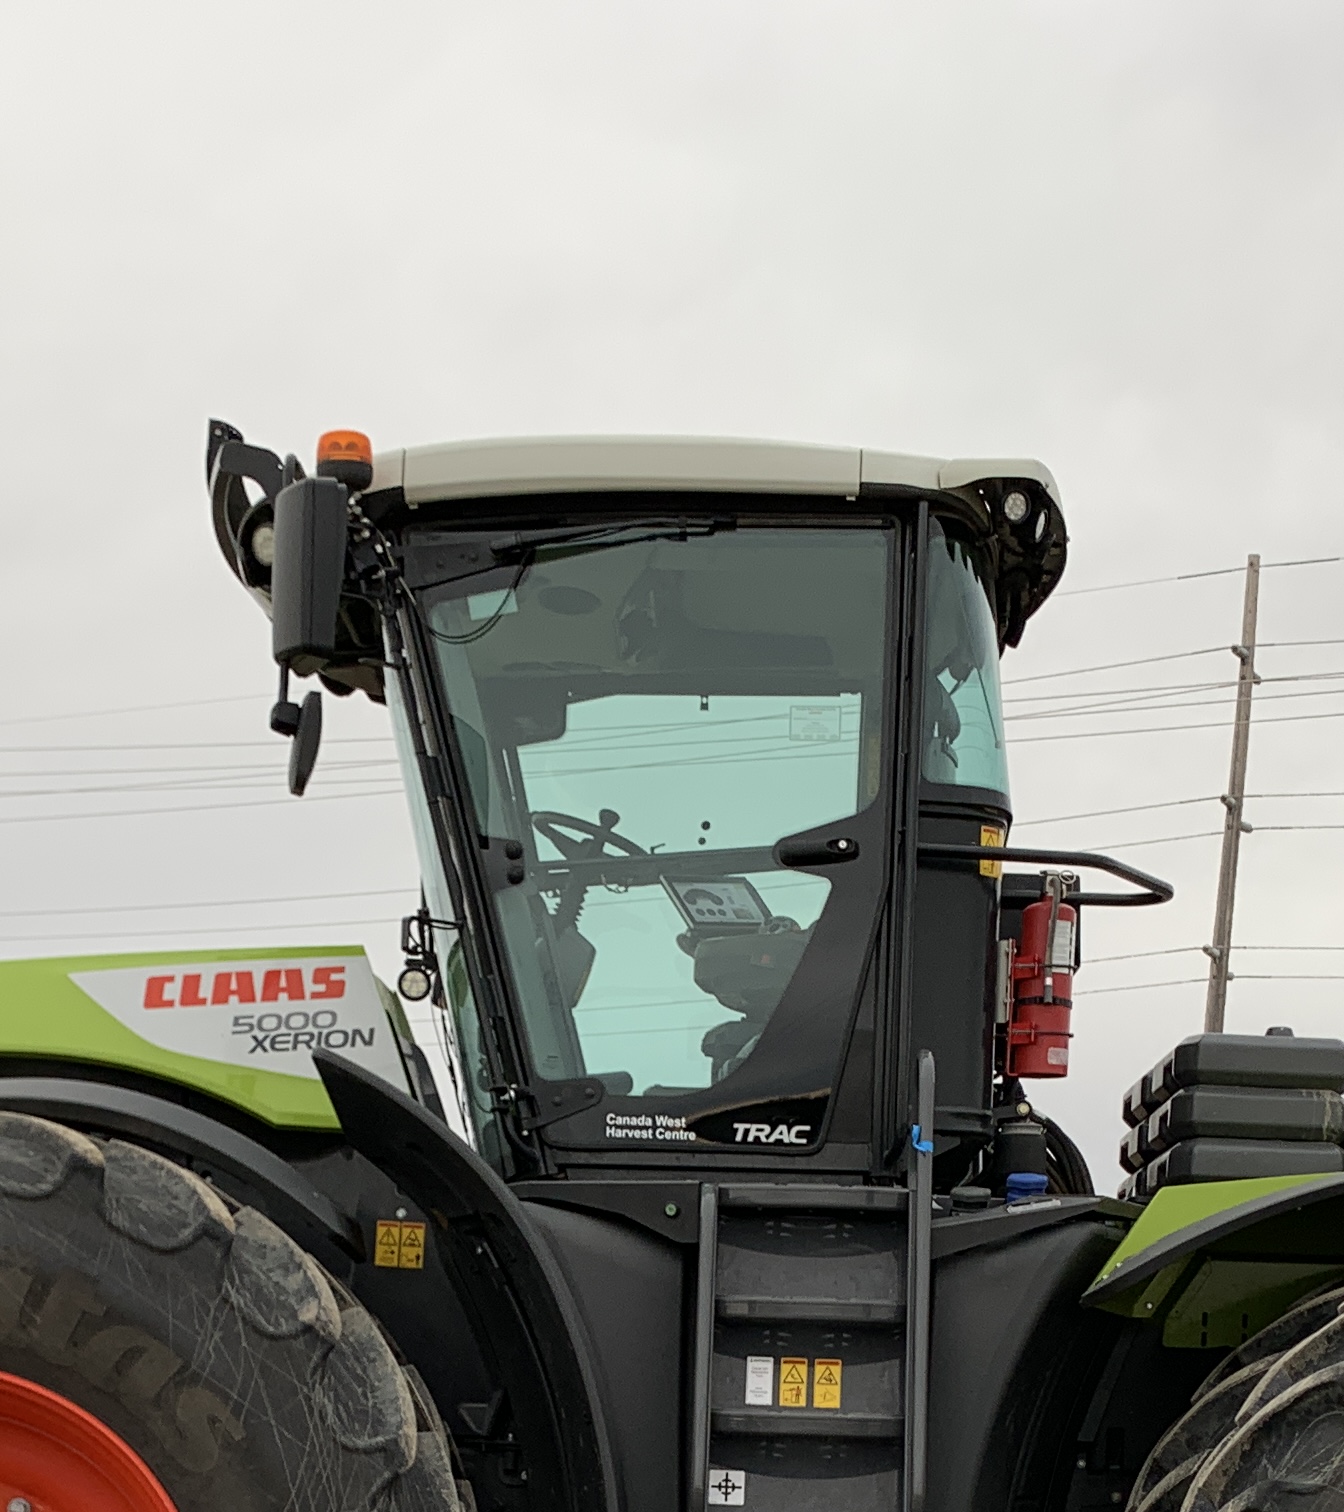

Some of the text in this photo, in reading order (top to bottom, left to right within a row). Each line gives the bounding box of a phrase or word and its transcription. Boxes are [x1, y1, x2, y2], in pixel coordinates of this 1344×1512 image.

[143, 966, 346, 1010] CLAAS
[231, 1010, 338, 1035] 5000
[248, 1027, 375, 1054] XERION
[606, 1113, 686, 1128] Canada West
[606, 1126, 696, 1141] Harvest Centre
[733, 1123, 811, 1144] TRAC
